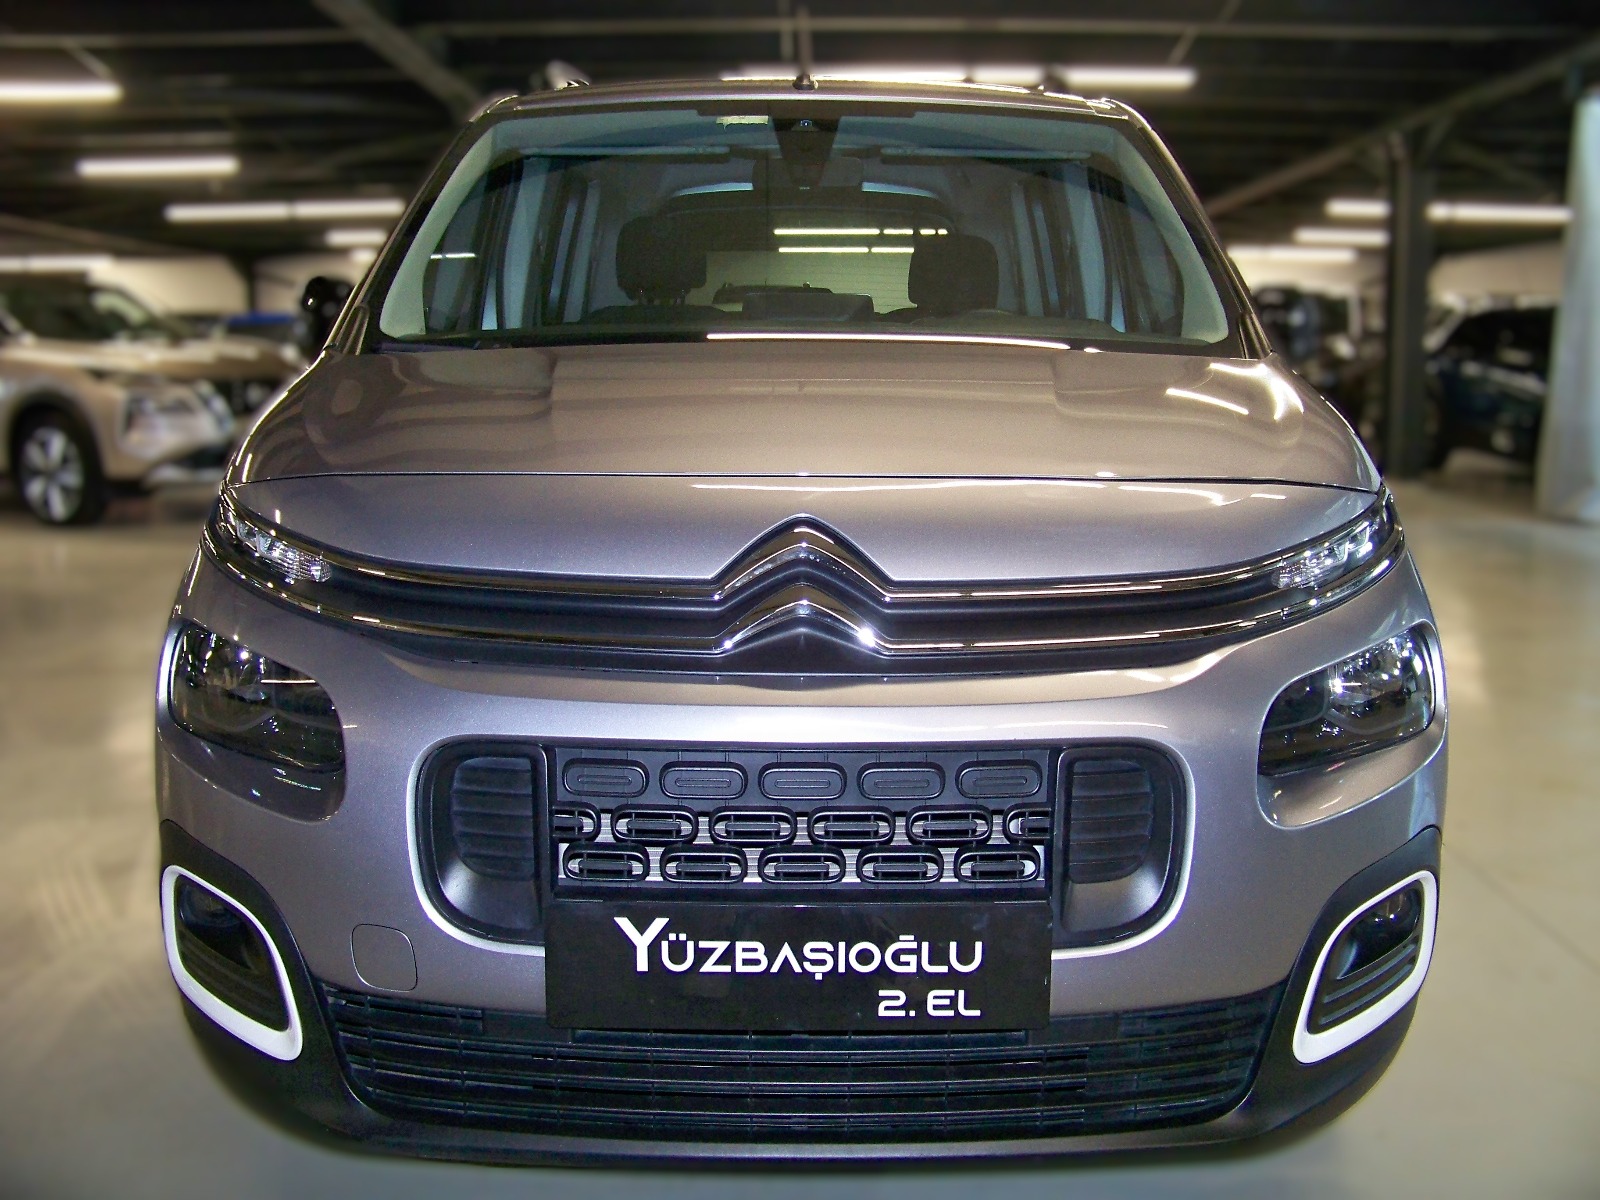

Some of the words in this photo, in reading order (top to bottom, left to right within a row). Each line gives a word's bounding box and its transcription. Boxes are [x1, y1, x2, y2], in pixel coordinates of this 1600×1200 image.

[614, 916, 983, 981] YÜZBAŞIOĞLU
[877, 989, 916, 1017] 2.
[926, 989, 981, 1017] EL
